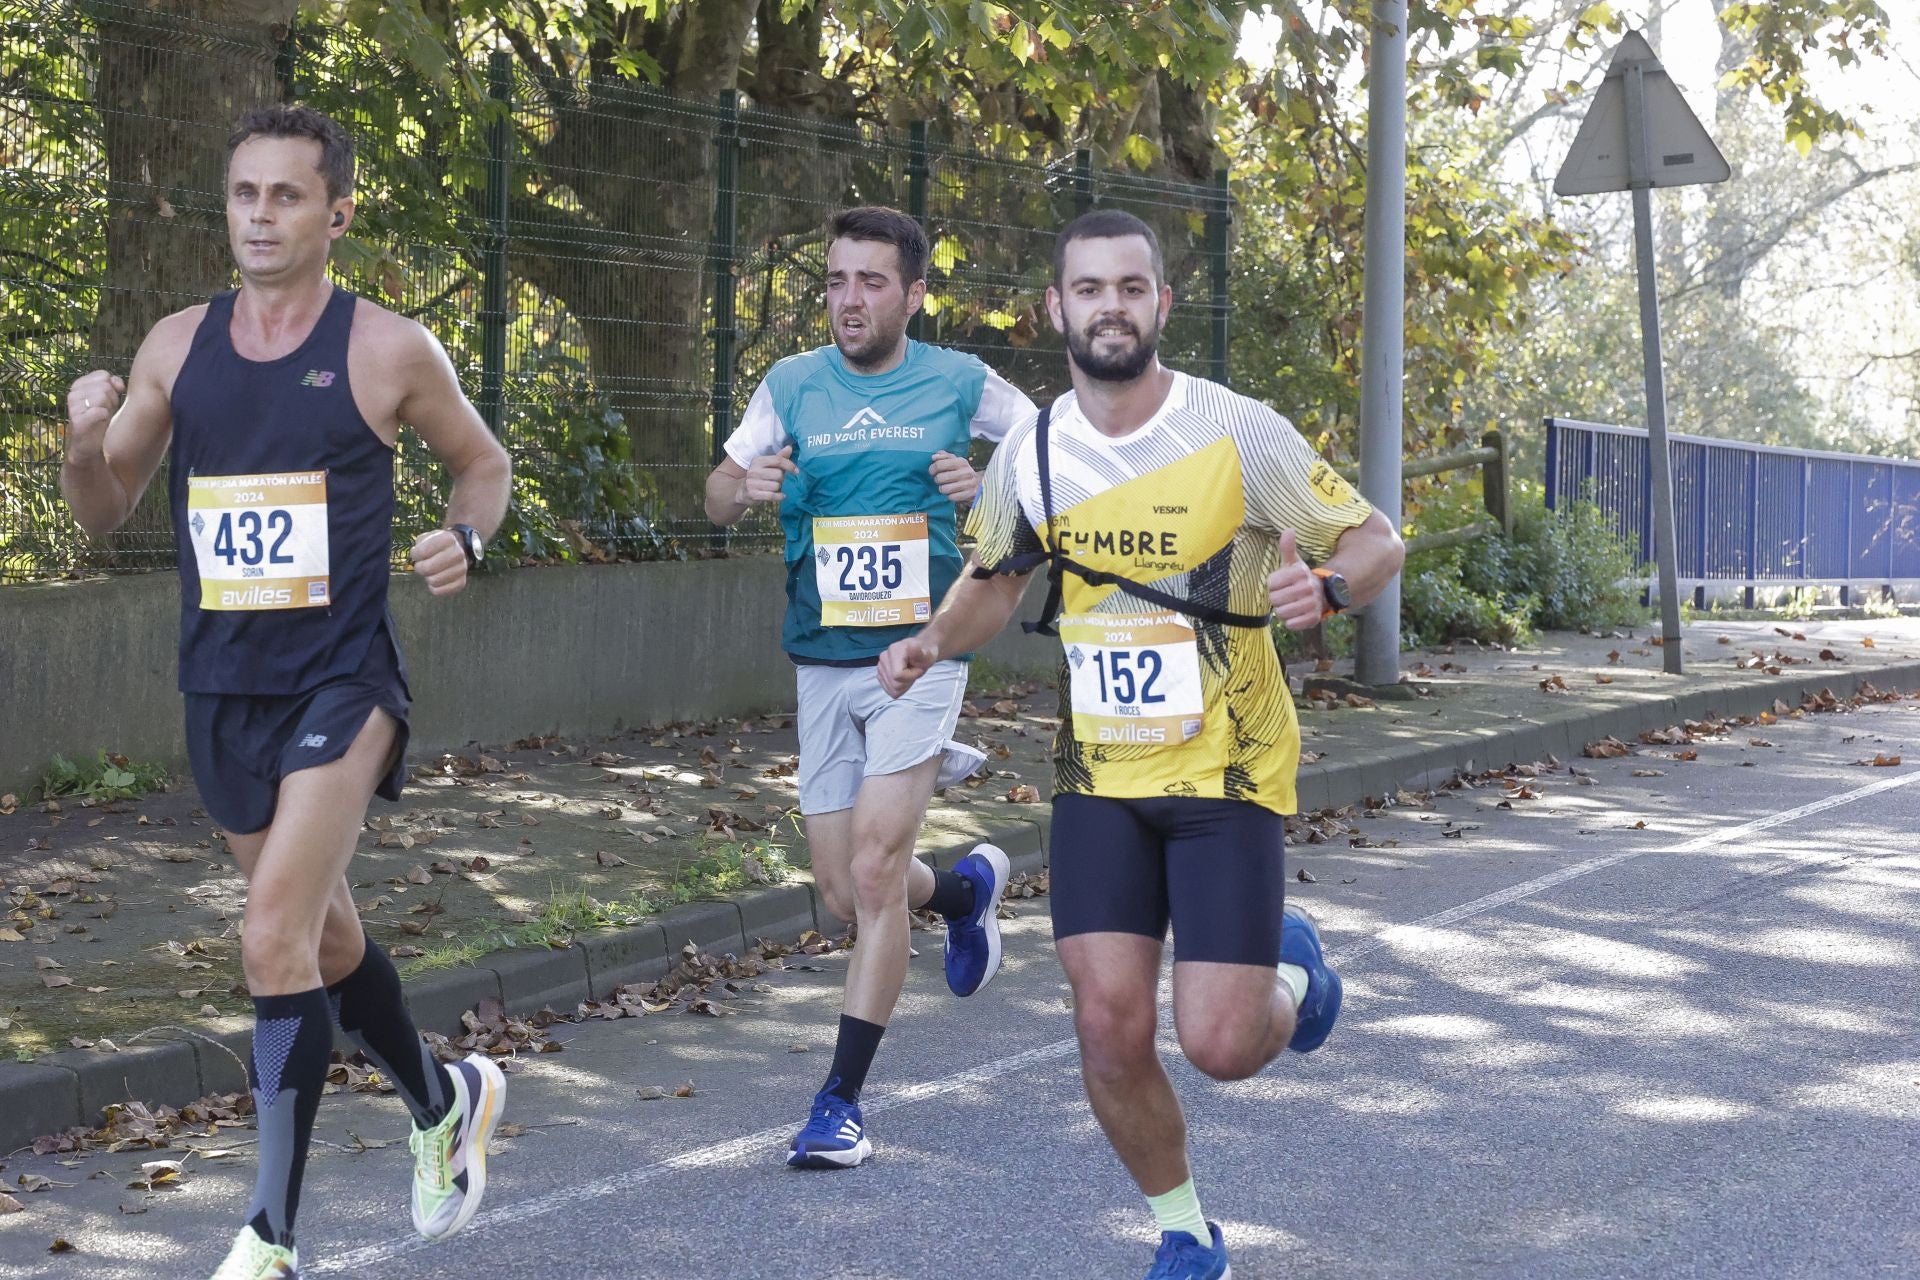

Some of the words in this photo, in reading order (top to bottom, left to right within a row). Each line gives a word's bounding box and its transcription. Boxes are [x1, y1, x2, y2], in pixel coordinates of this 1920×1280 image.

[807, 433, 831, 448] FIND
[870, 426, 925, 440] EVEREST
[288, 474, 322, 485] AVILÉS
[233, 491, 265, 503] 2024
[1153, 505, 1188, 514] VESKIN
[833, 519, 856, 528] MEDIA
[857, 516, 898, 527] MARATÓN
[898, 514, 925, 525] AVILÉS
[214, 509, 294, 566] 432
[853, 530, 879, 540] 2024
[241, 567, 264, 578] SORIN
[836, 544, 903, 591] 235
[221, 586, 293, 606] avilés
[845, 606, 901, 623] avilés
[1104, 632, 1133, 643] 2024
[1093, 649, 1166, 704] 152
[1119, 706, 1141, 716] ROCES
[1099, 724, 1166, 742] avilés
